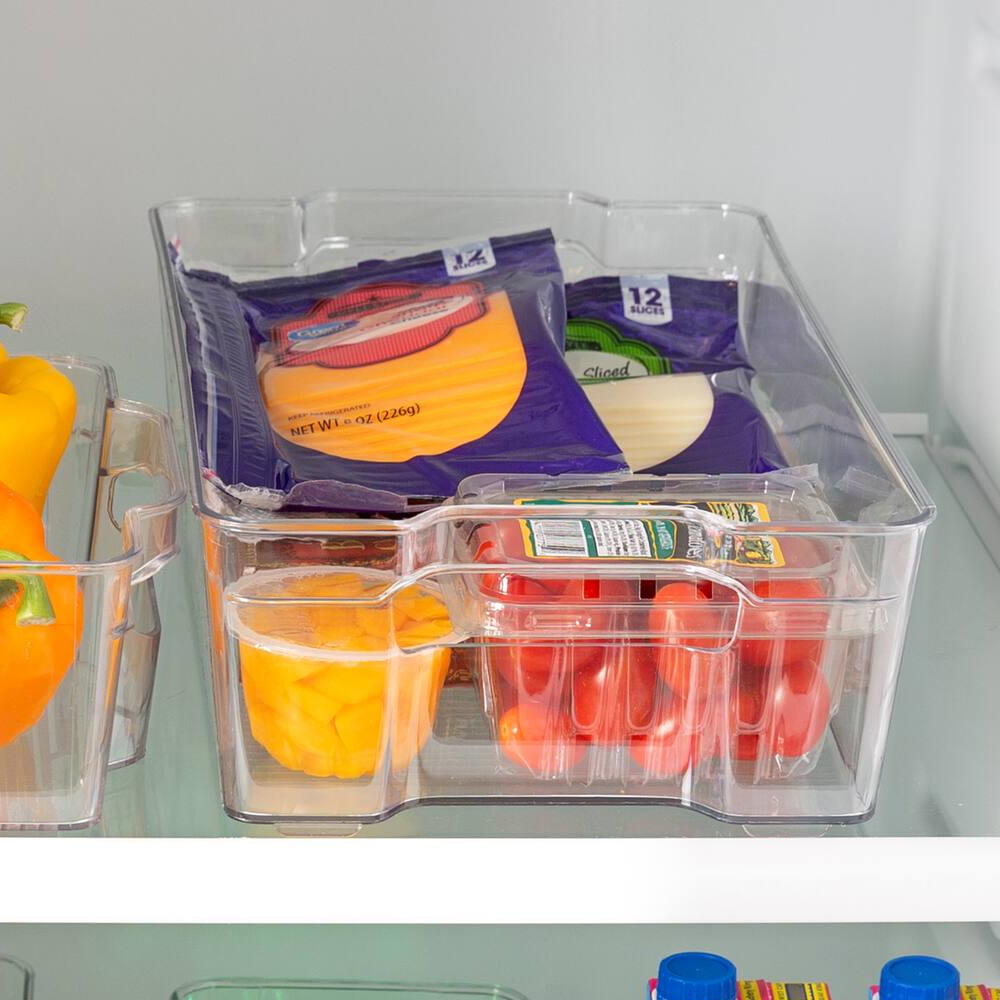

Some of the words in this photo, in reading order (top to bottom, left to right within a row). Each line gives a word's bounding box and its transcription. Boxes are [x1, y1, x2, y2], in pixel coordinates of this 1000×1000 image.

[628, 288, 662, 306] 12
[630, 306, 664, 315] SLICES
[584, 361, 630, 378] Sliced
[291, 423, 315, 436] NET
[356, 414, 374, 424] OZ
[377, 403, 420, 422] (226g)
